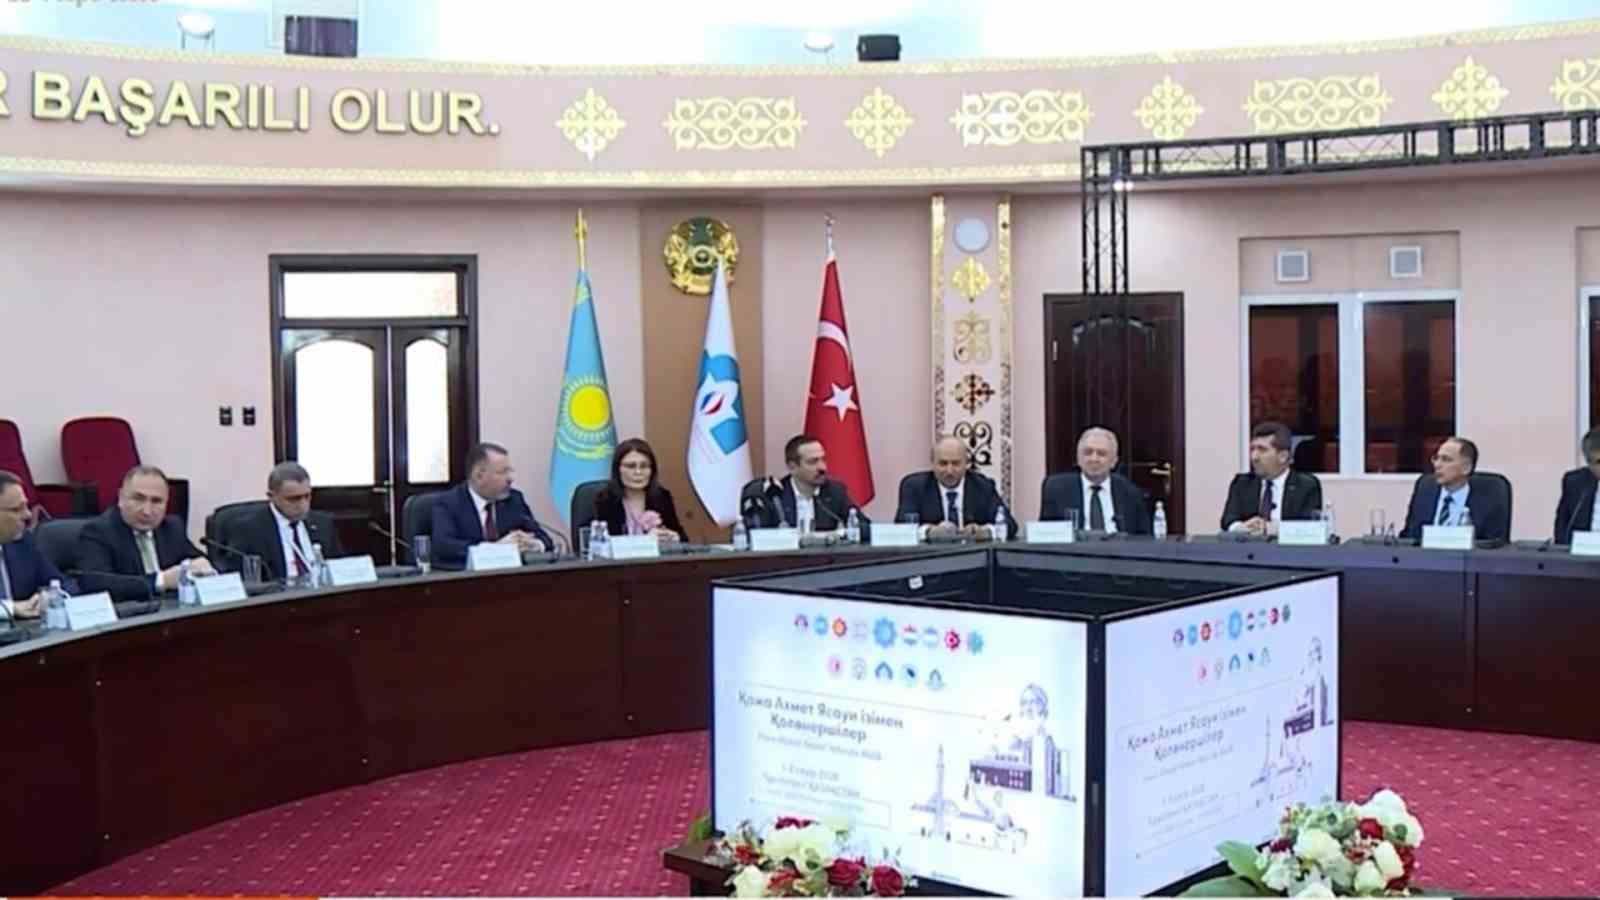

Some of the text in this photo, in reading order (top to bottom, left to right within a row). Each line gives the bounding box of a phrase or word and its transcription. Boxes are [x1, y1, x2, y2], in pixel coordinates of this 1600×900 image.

[32, 71, 311, 137] BAŞARILI
[329, 88, 502, 136] OLUR.
[774, 696, 815, 715] Ахмет
